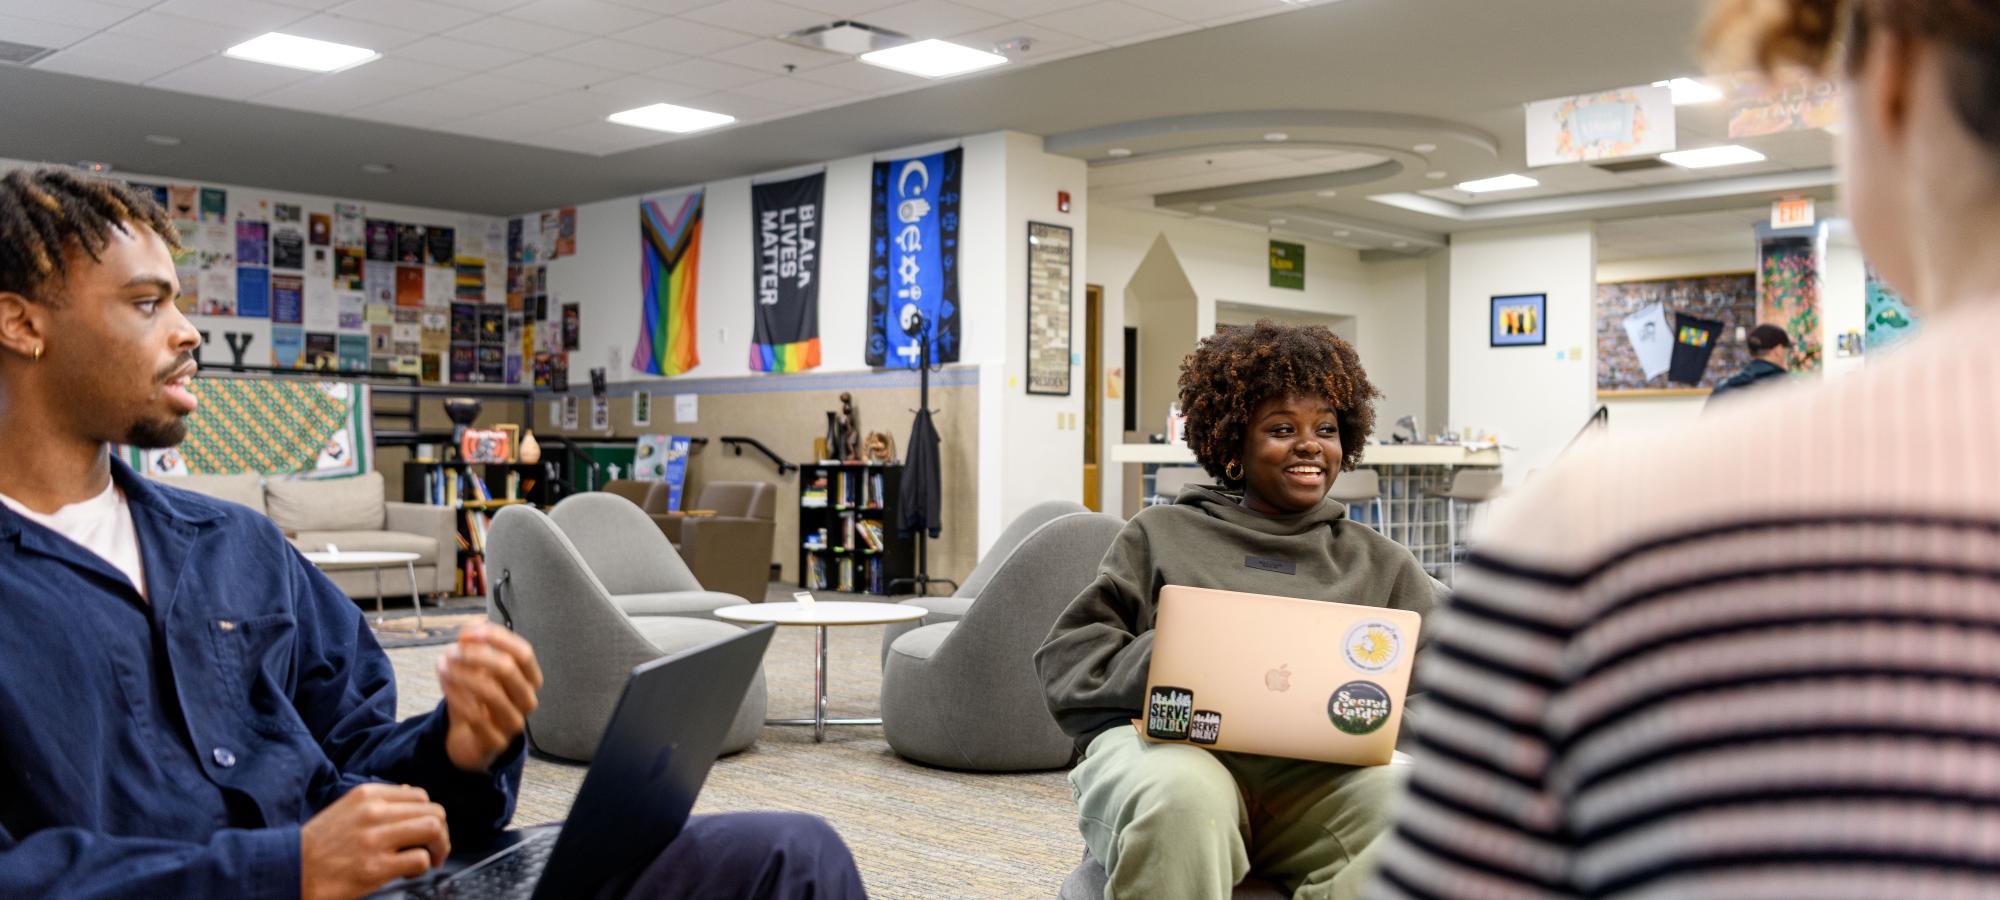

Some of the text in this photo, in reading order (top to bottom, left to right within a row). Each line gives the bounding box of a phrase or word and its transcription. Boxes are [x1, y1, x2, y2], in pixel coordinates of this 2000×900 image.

[1778, 200, 1808, 225] EXIT
[780, 207, 797, 278] LIVES
[760, 210, 778, 305] MATTER
[1338, 691, 1387, 708] Secret
[1151, 703, 1189, 721] SERVE
[1333, 701, 1387, 719] Garden
[1150, 719, 1188, 732] BOLDLY
[1191, 729, 1217, 740] BOLDLY
[1192, 720, 1218, 732] SERVE
